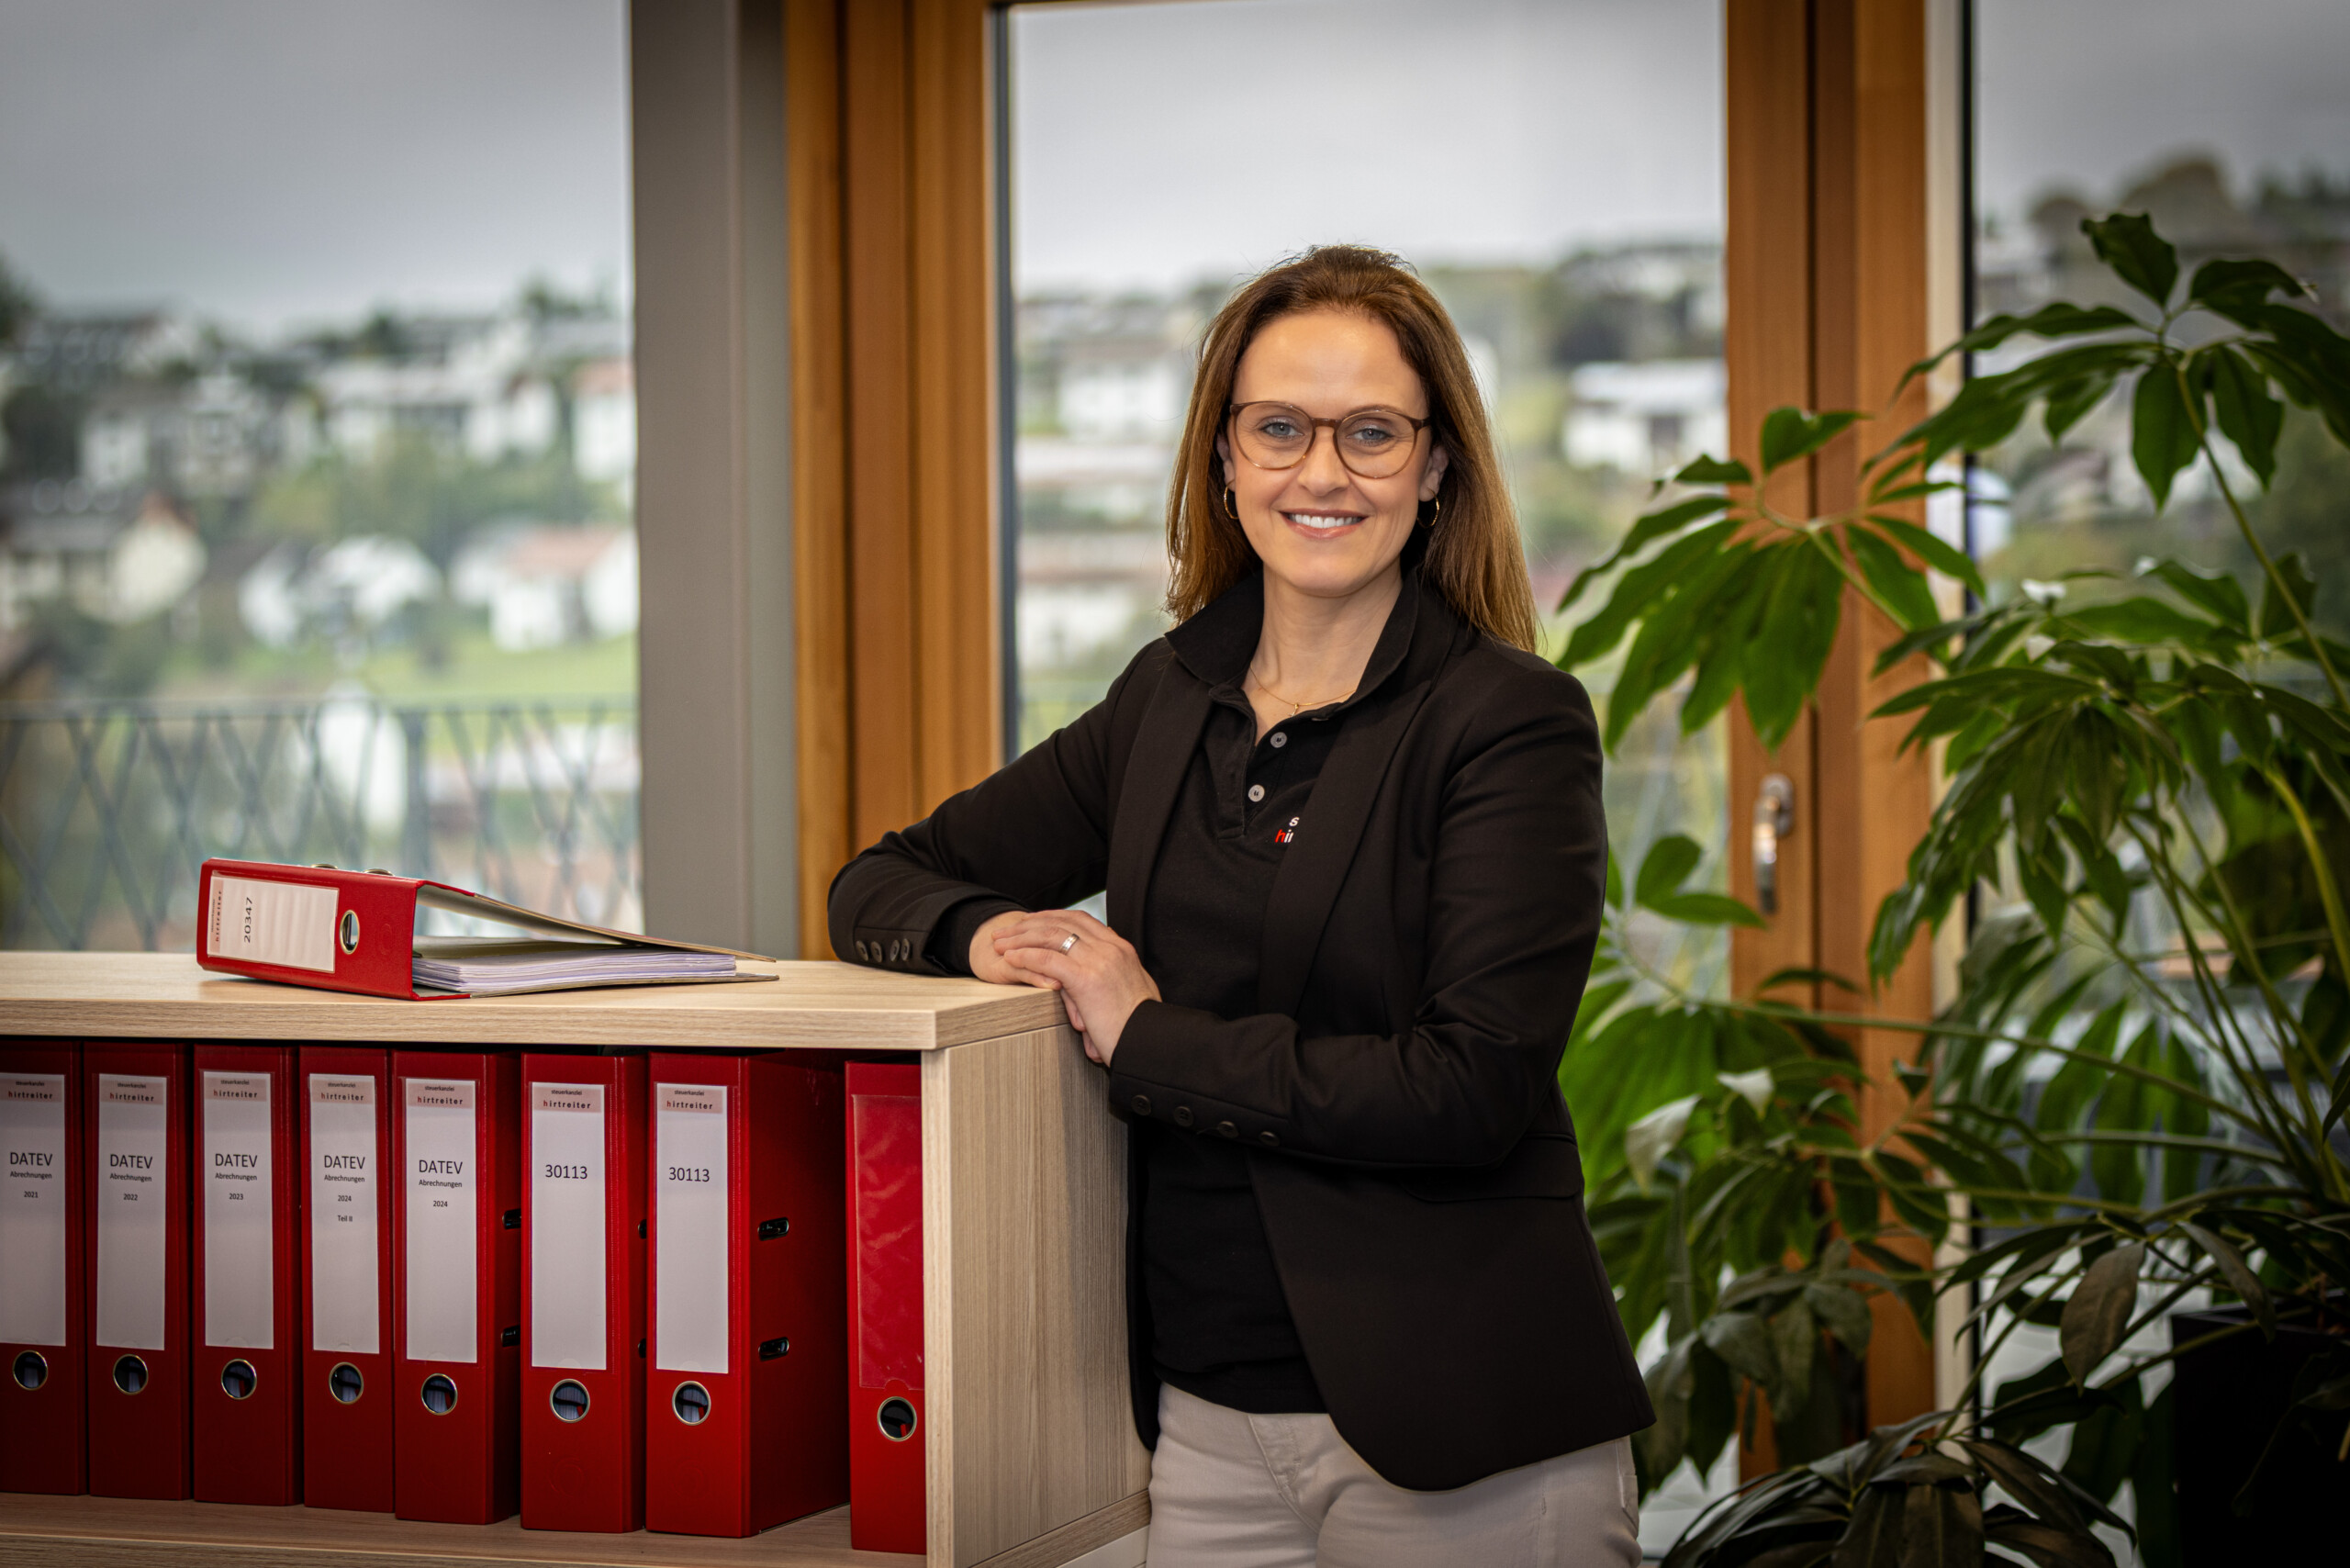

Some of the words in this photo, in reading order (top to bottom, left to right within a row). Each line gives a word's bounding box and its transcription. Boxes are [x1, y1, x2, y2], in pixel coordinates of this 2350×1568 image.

[244, 897, 252, 943] 20347
[8, 1091, 53, 1100] hirtreiter
[109, 1092, 154, 1103] hirtreiter
[213, 1090, 258, 1099] hirtreiter
[321, 1092, 364, 1102] hirtreiter
[674, 1089, 705, 1097] steuerkanzlei
[417, 1096, 463, 1105] hirtreiter
[543, 1100, 591, 1110] hirtreiter
[666, 1100, 713, 1111] hirtreiter
[10, 1152, 53, 1167] DATEV
[109, 1154, 153, 1170] DATEV
[215, 1153, 258, 1168] DATEV
[324, 1155, 365, 1170] DATEV
[419, 1159, 463, 1175] DATEV
[545, 1164, 588, 1180] 30113
[10, 1170, 52, 1180] Abrechnungen
[109, 1172, 152, 1182] Abrechnungen
[215, 1171, 258, 1182] Abrechnungen
[324, 1174, 365, 1183] Abrechnungen
[668, 1167, 710, 1182] 30113
[419, 1179, 463, 1189] Abrechnungen
[229, 1193, 244, 1201] 2023
[337, 1194, 352, 1203] 2024
[432, 1200, 448, 1208] 2024
[337, 1215, 348, 1223] Teil
